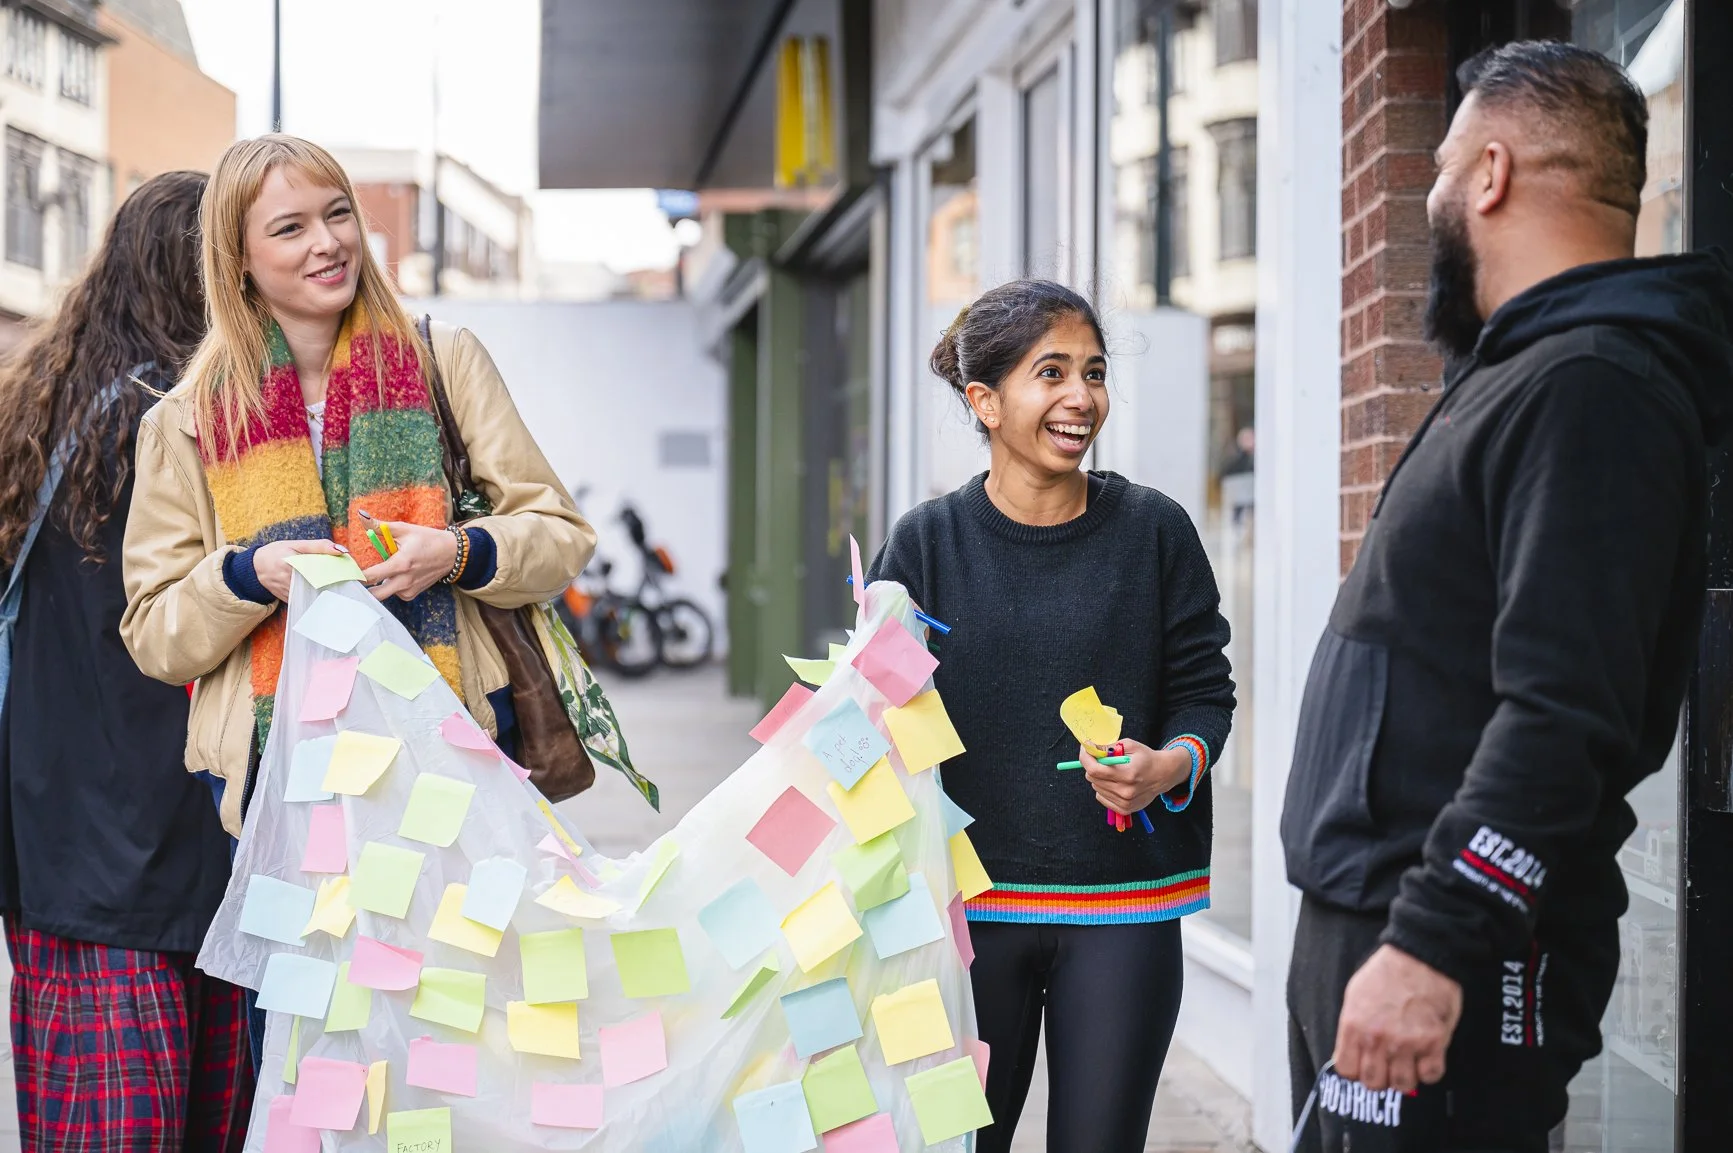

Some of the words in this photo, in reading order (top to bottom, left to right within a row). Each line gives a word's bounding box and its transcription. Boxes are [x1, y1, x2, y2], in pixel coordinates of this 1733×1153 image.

[821, 750, 833, 762] A
[834, 733, 847, 758] pet
[1501, 960, 1525, 1046] EST.2014
[397, 1138, 441, 1153] FACTORY
